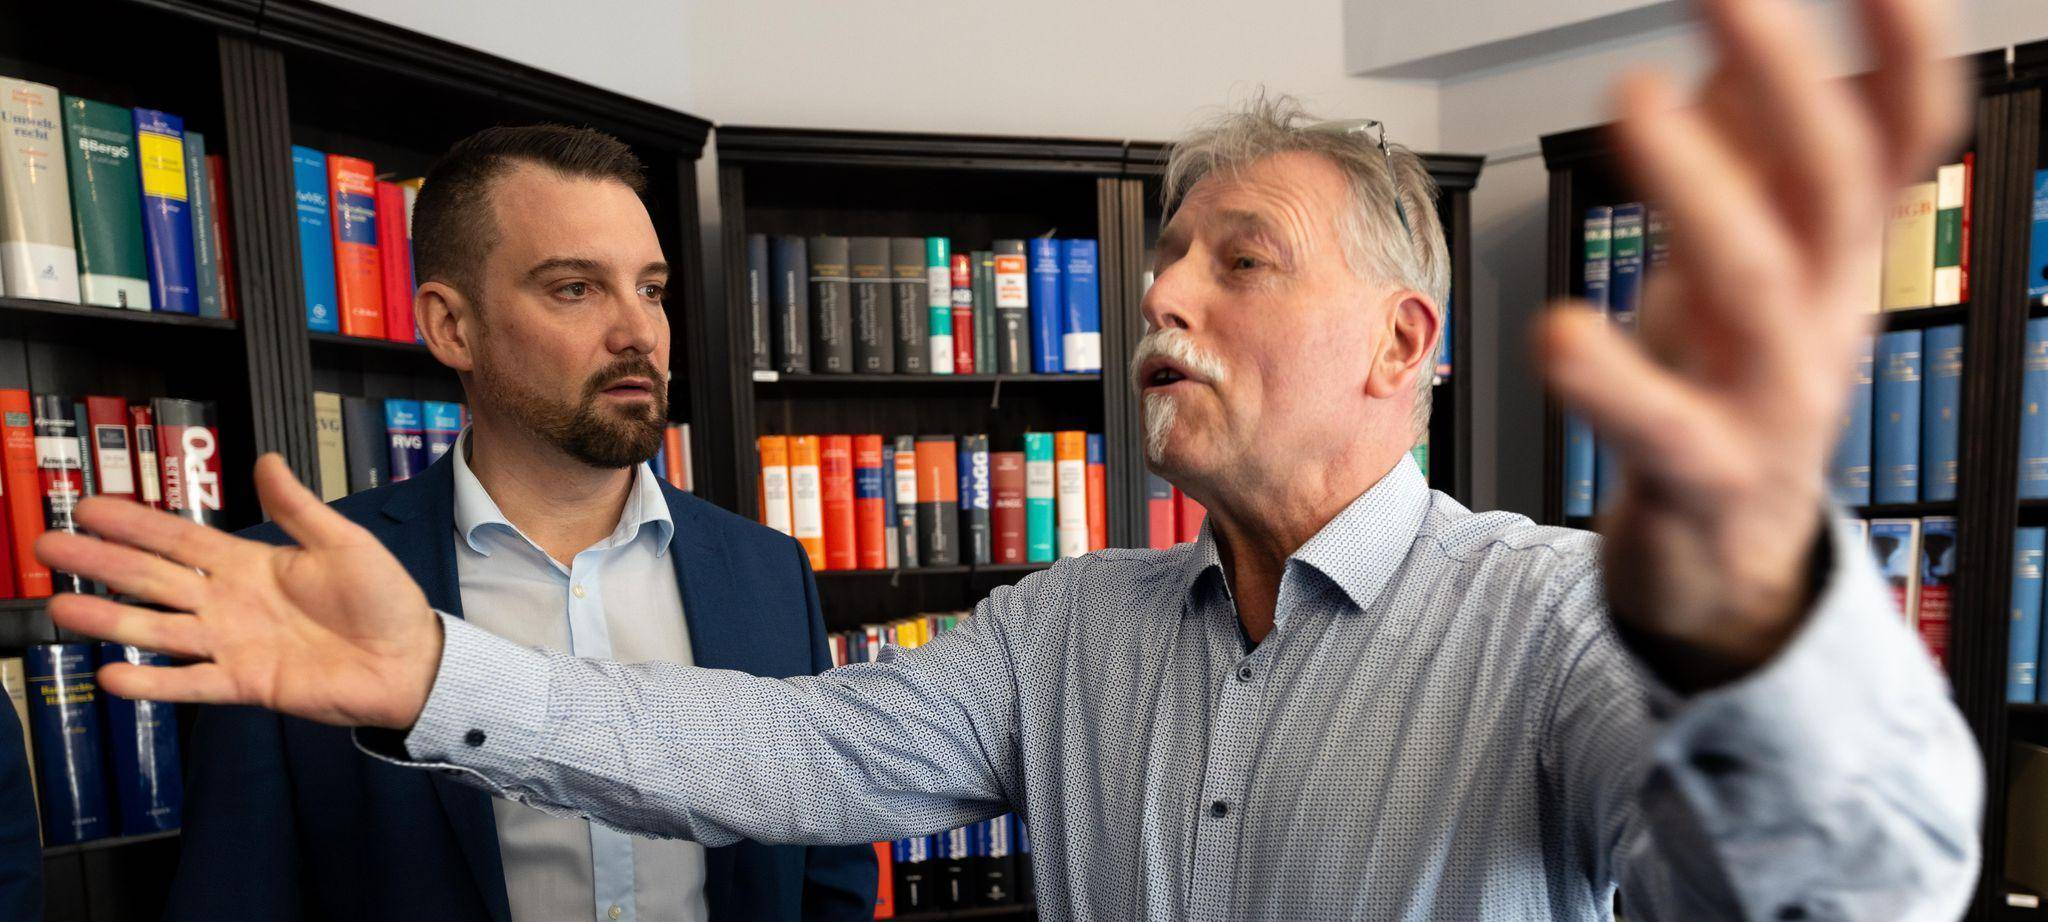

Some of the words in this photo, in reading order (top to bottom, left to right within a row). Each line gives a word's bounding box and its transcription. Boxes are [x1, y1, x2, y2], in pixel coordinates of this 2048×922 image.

[182, 426, 221, 511] ZPO
[392, 434, 423, 449] RVG
[972, 451, 989, 510] ArbGG
